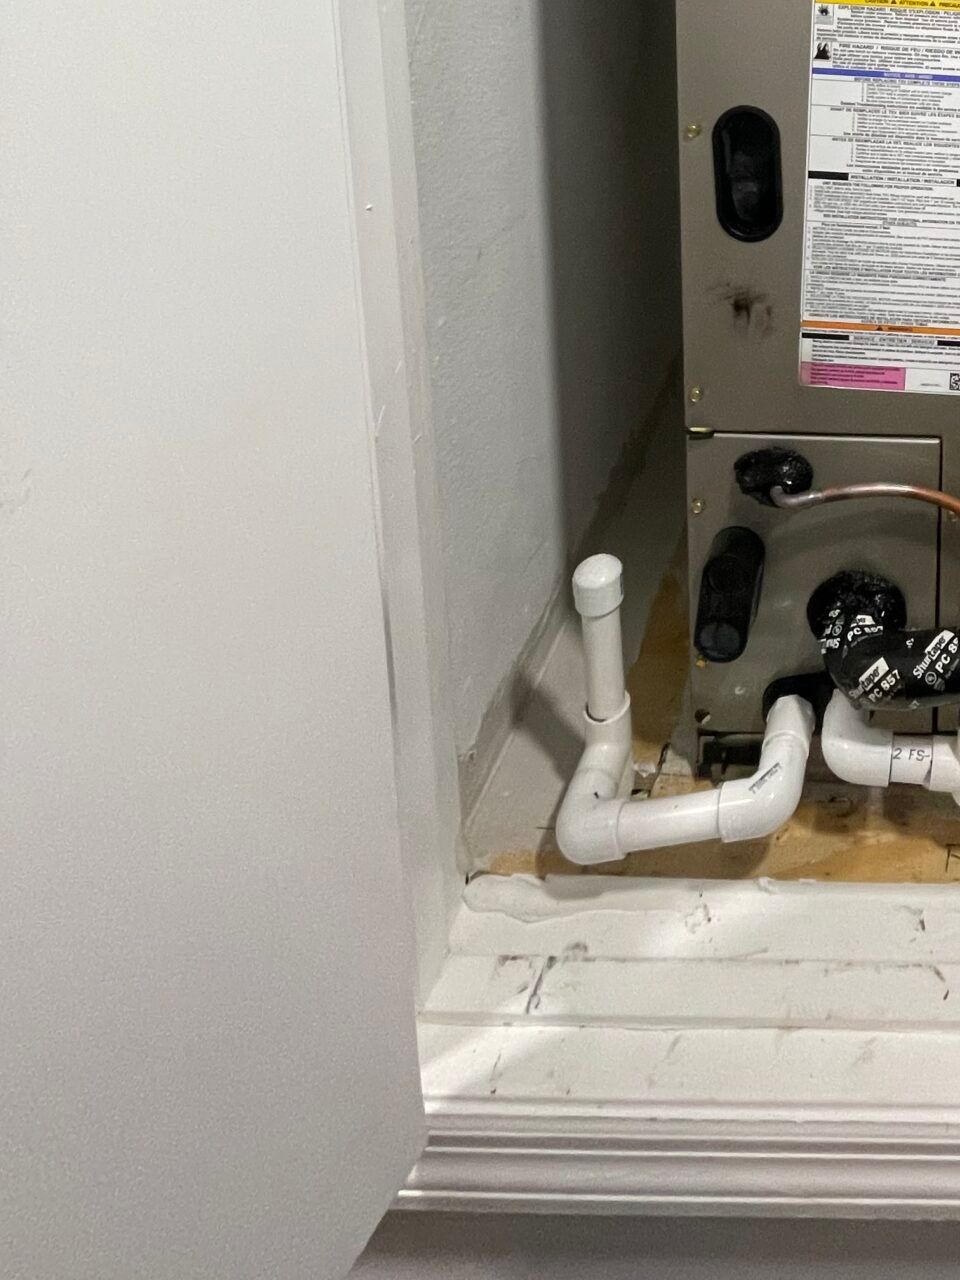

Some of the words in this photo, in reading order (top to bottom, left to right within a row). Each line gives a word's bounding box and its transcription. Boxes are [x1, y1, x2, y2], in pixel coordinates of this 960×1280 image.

[899, 0, 929, 7] ATTENTION
[847, 627, 862, 641] PC
[912, 632, 952, 679] Shurtape
[935, 653, 951, 674] PC
[849, 659, 886, 699] Shurtape
[880, 668, 900, 692] 857
[868, 687, 883, 703] PC
[892, 747, 903, 760] 2
